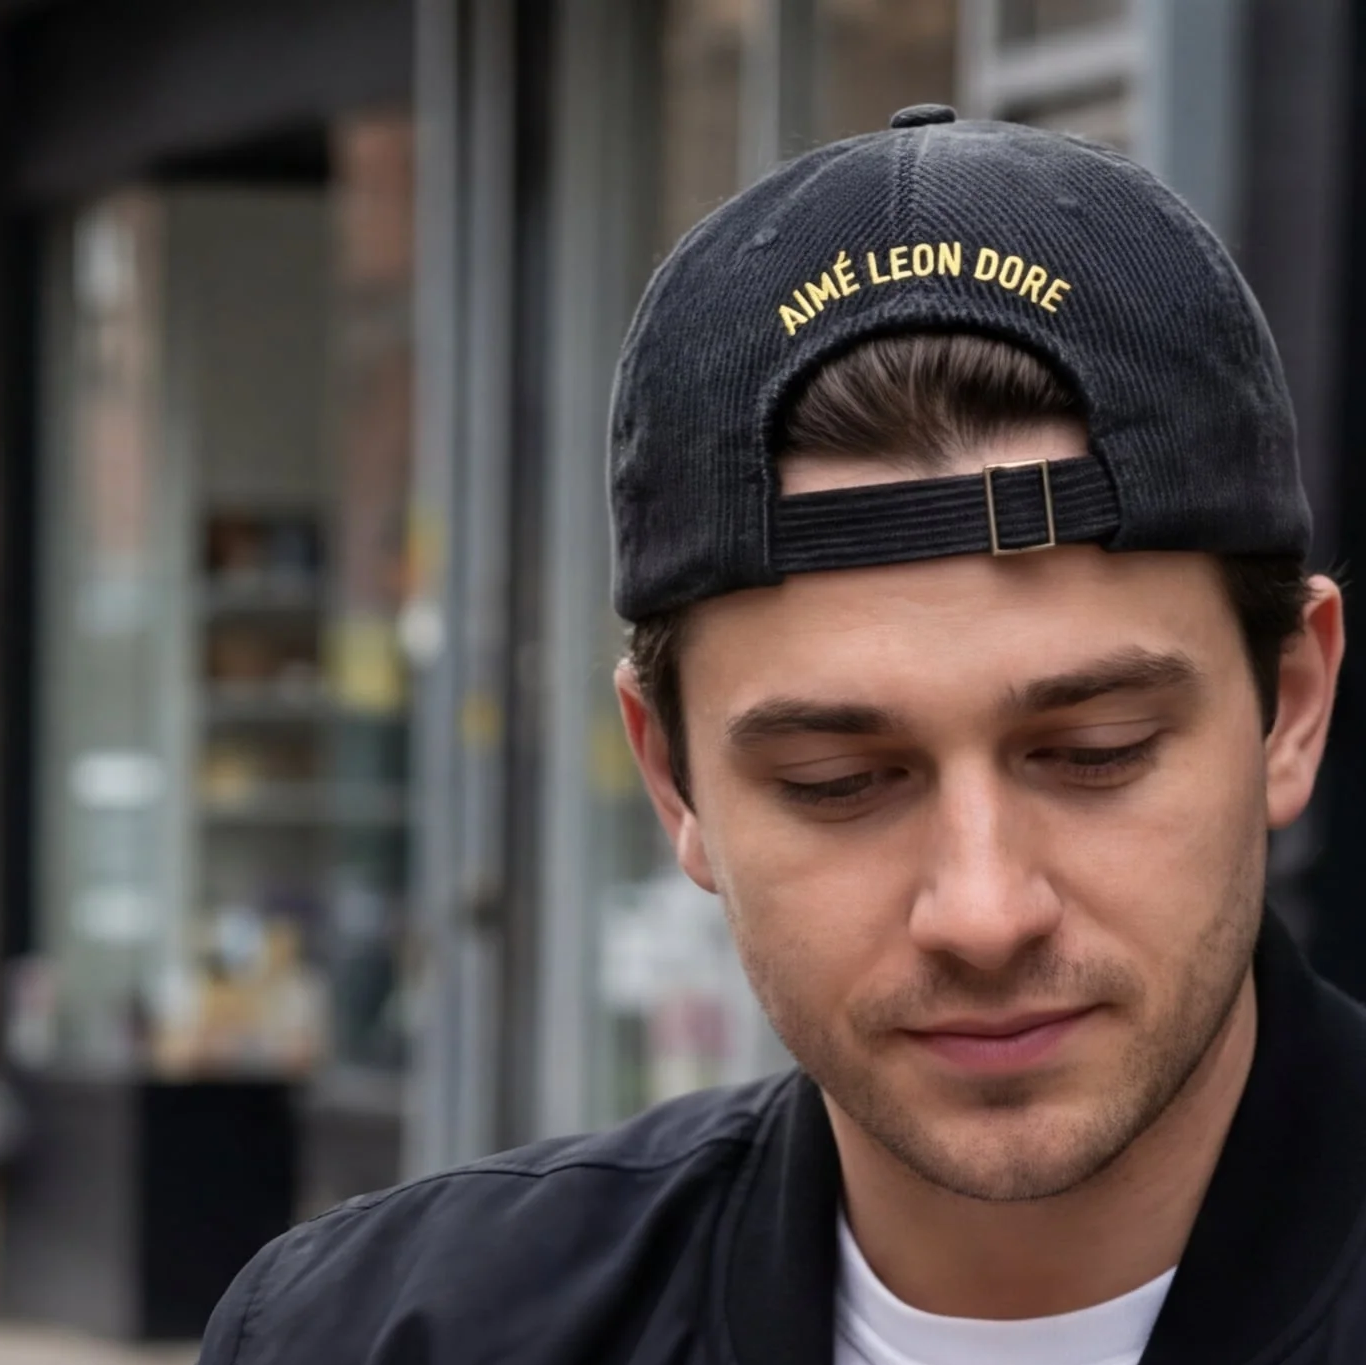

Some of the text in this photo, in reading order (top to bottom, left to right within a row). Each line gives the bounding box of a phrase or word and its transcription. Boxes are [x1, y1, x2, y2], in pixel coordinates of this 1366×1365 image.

[778, 241, 1071, 335] AIMÉ LEON DORE
